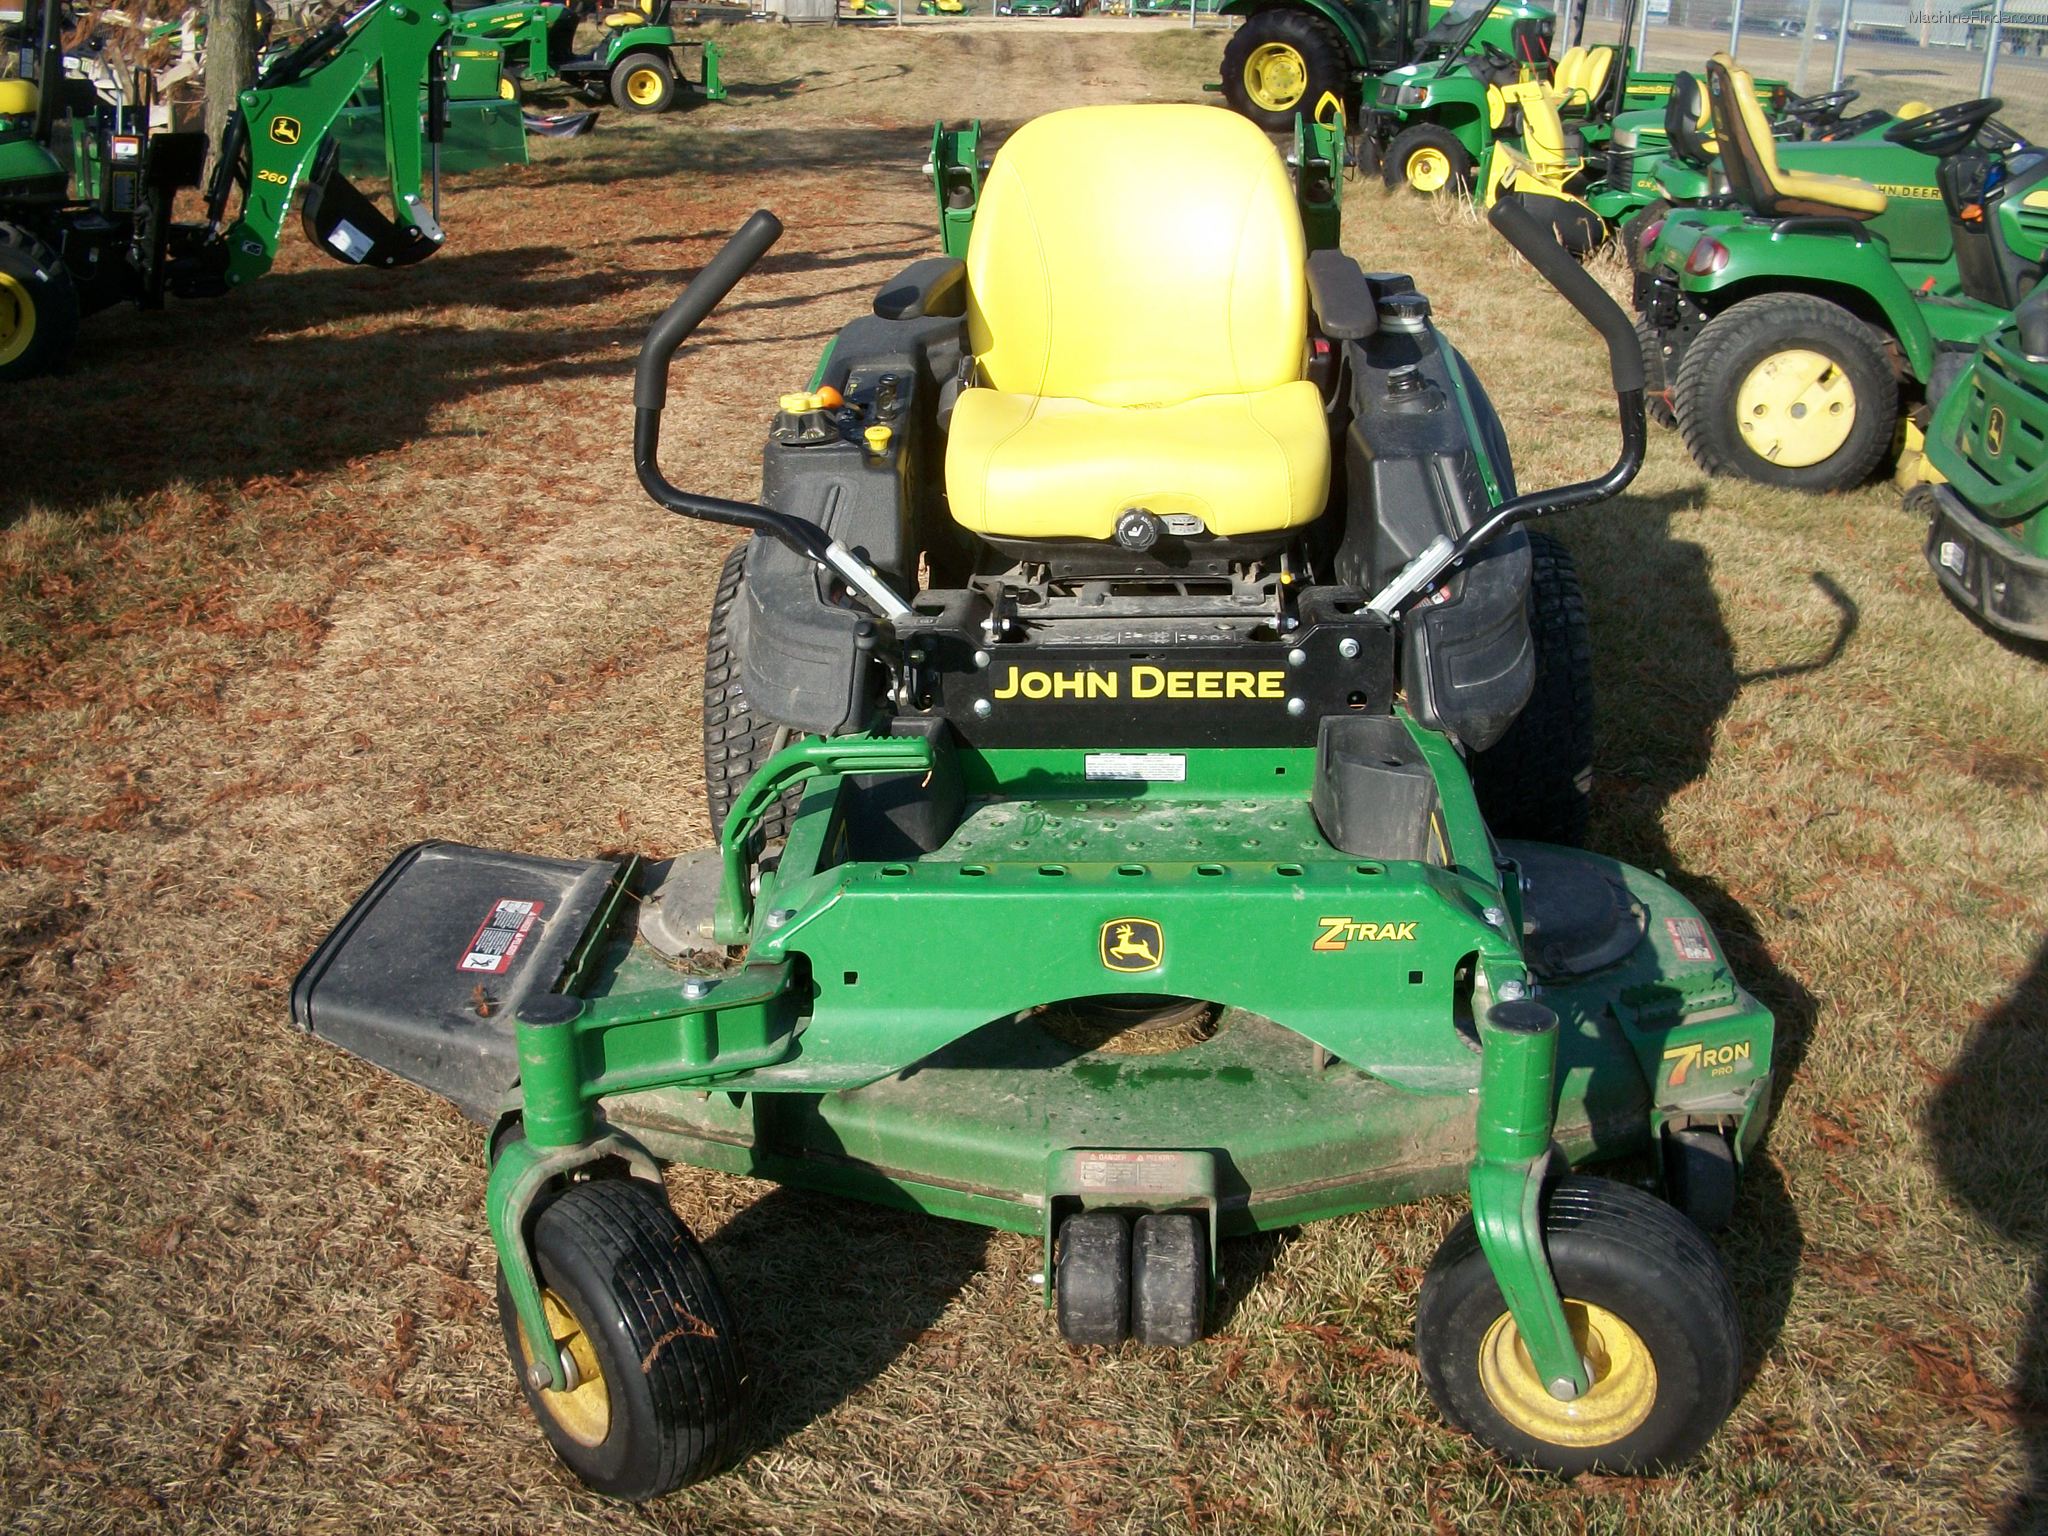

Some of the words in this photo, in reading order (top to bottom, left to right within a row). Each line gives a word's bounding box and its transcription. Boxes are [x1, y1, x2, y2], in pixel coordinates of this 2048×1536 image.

[257, 170, 288, 185] 260
[994, 666, 1118, 699] JOHN
[1131, 666, 1285, 698] DEERE
[1711, 1065, 1733, 1078] PRO
